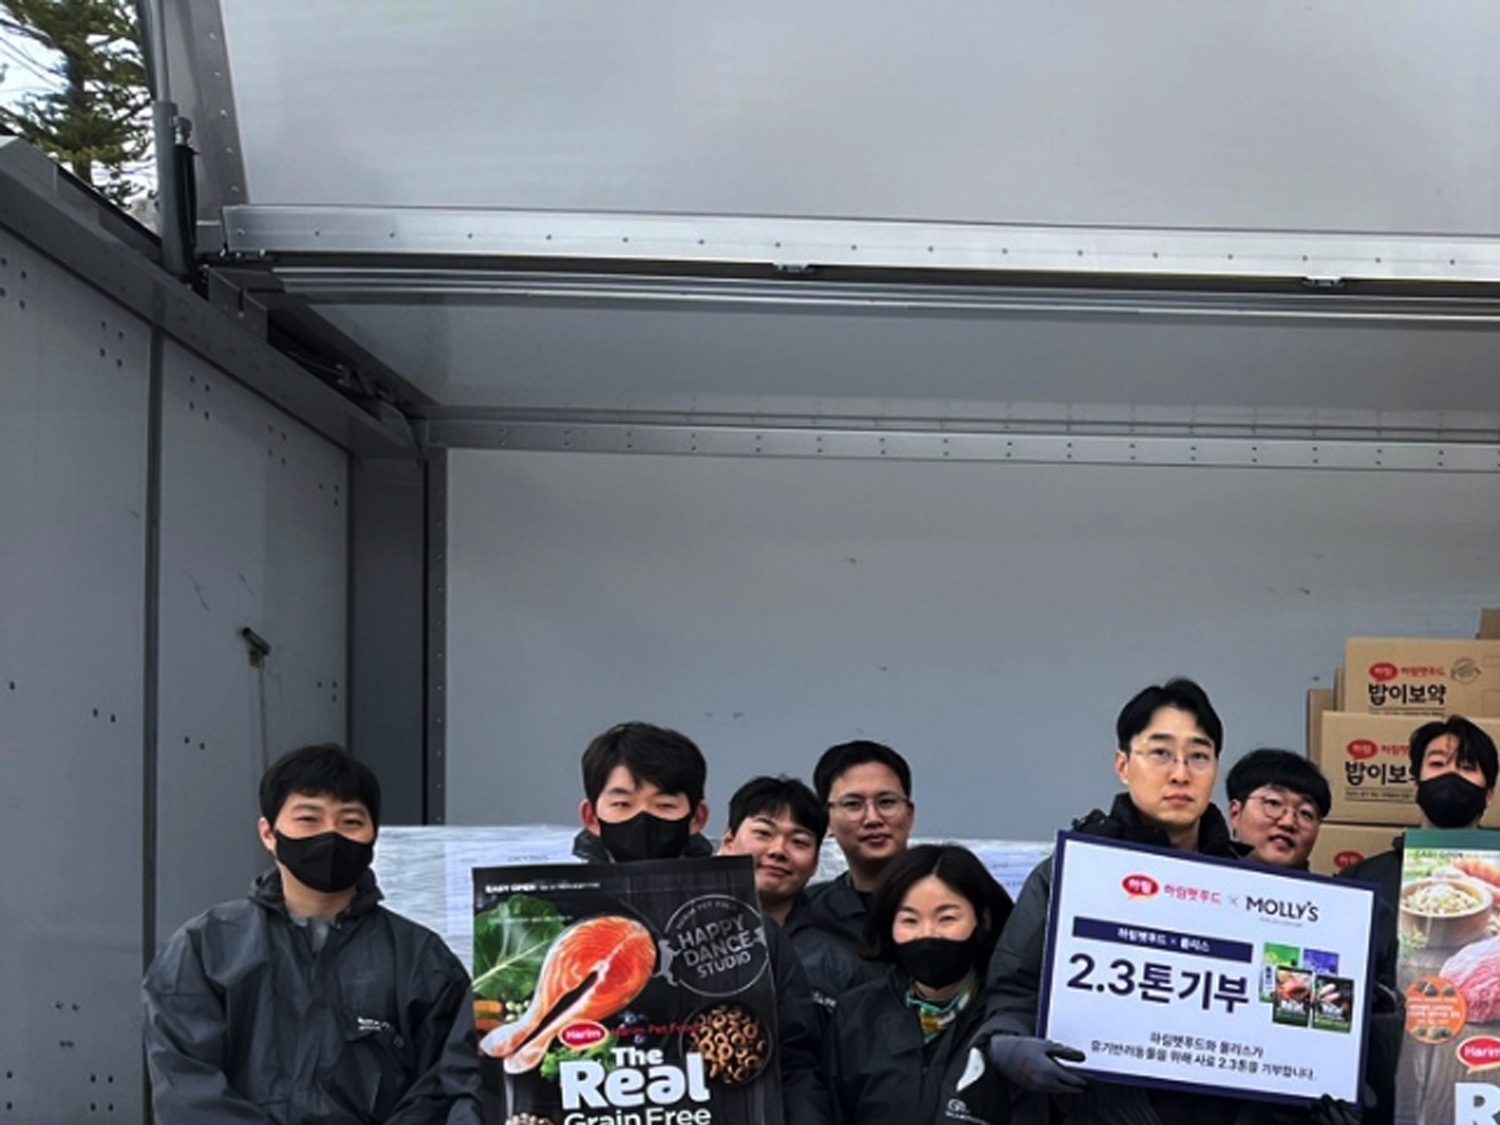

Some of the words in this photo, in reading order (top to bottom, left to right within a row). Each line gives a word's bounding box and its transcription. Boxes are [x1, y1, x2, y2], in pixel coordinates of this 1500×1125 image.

[1368, 684, 1446, 706] 밥이보약
[1345, 762, 1416, 786] 밥이보
[1164, 884, 1222, 905] 하림펫푸드
[1246, 897, 1319, 922] MOLLY'S
[678, 914, 744, 949] HAPPY
[683, 930, 753, 966] DANCE
[697, 951, 750, 978] STUDIO
[612, 1047, 664, 1067] The
[560, 1052, 710, 1110] Real
